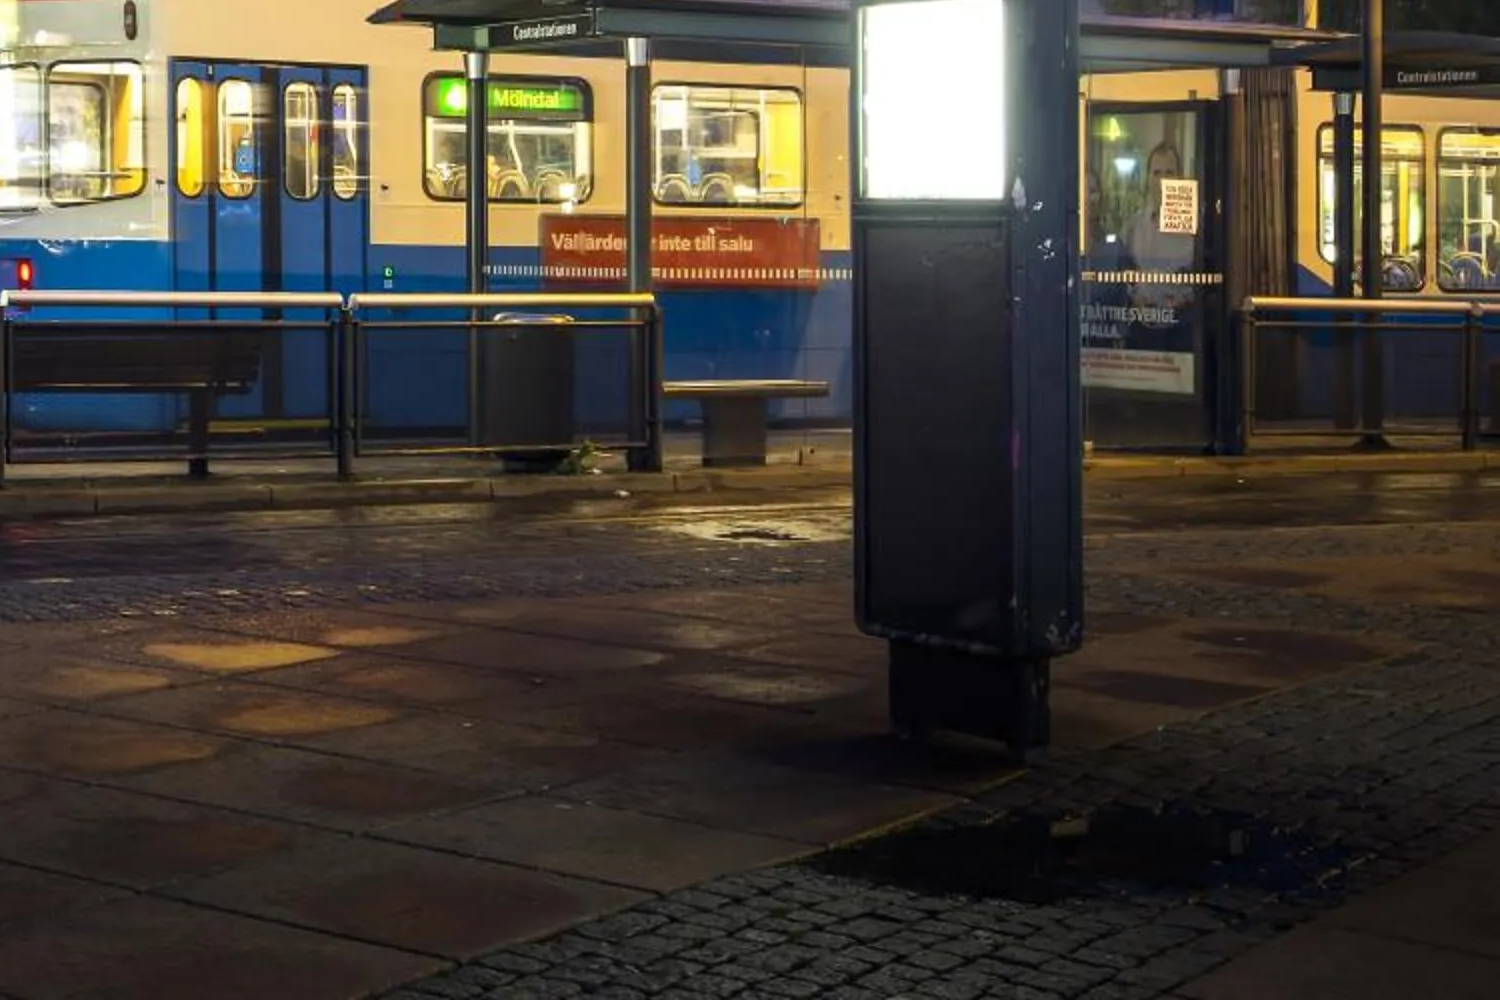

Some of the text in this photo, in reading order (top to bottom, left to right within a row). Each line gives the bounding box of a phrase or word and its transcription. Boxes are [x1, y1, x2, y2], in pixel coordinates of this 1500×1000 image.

[493, 88, 560, 109] Mölndal
[659, 234, 690, 251] inte
[694, 232, 716, 251] till
[719, 233, 754, 251] salu
